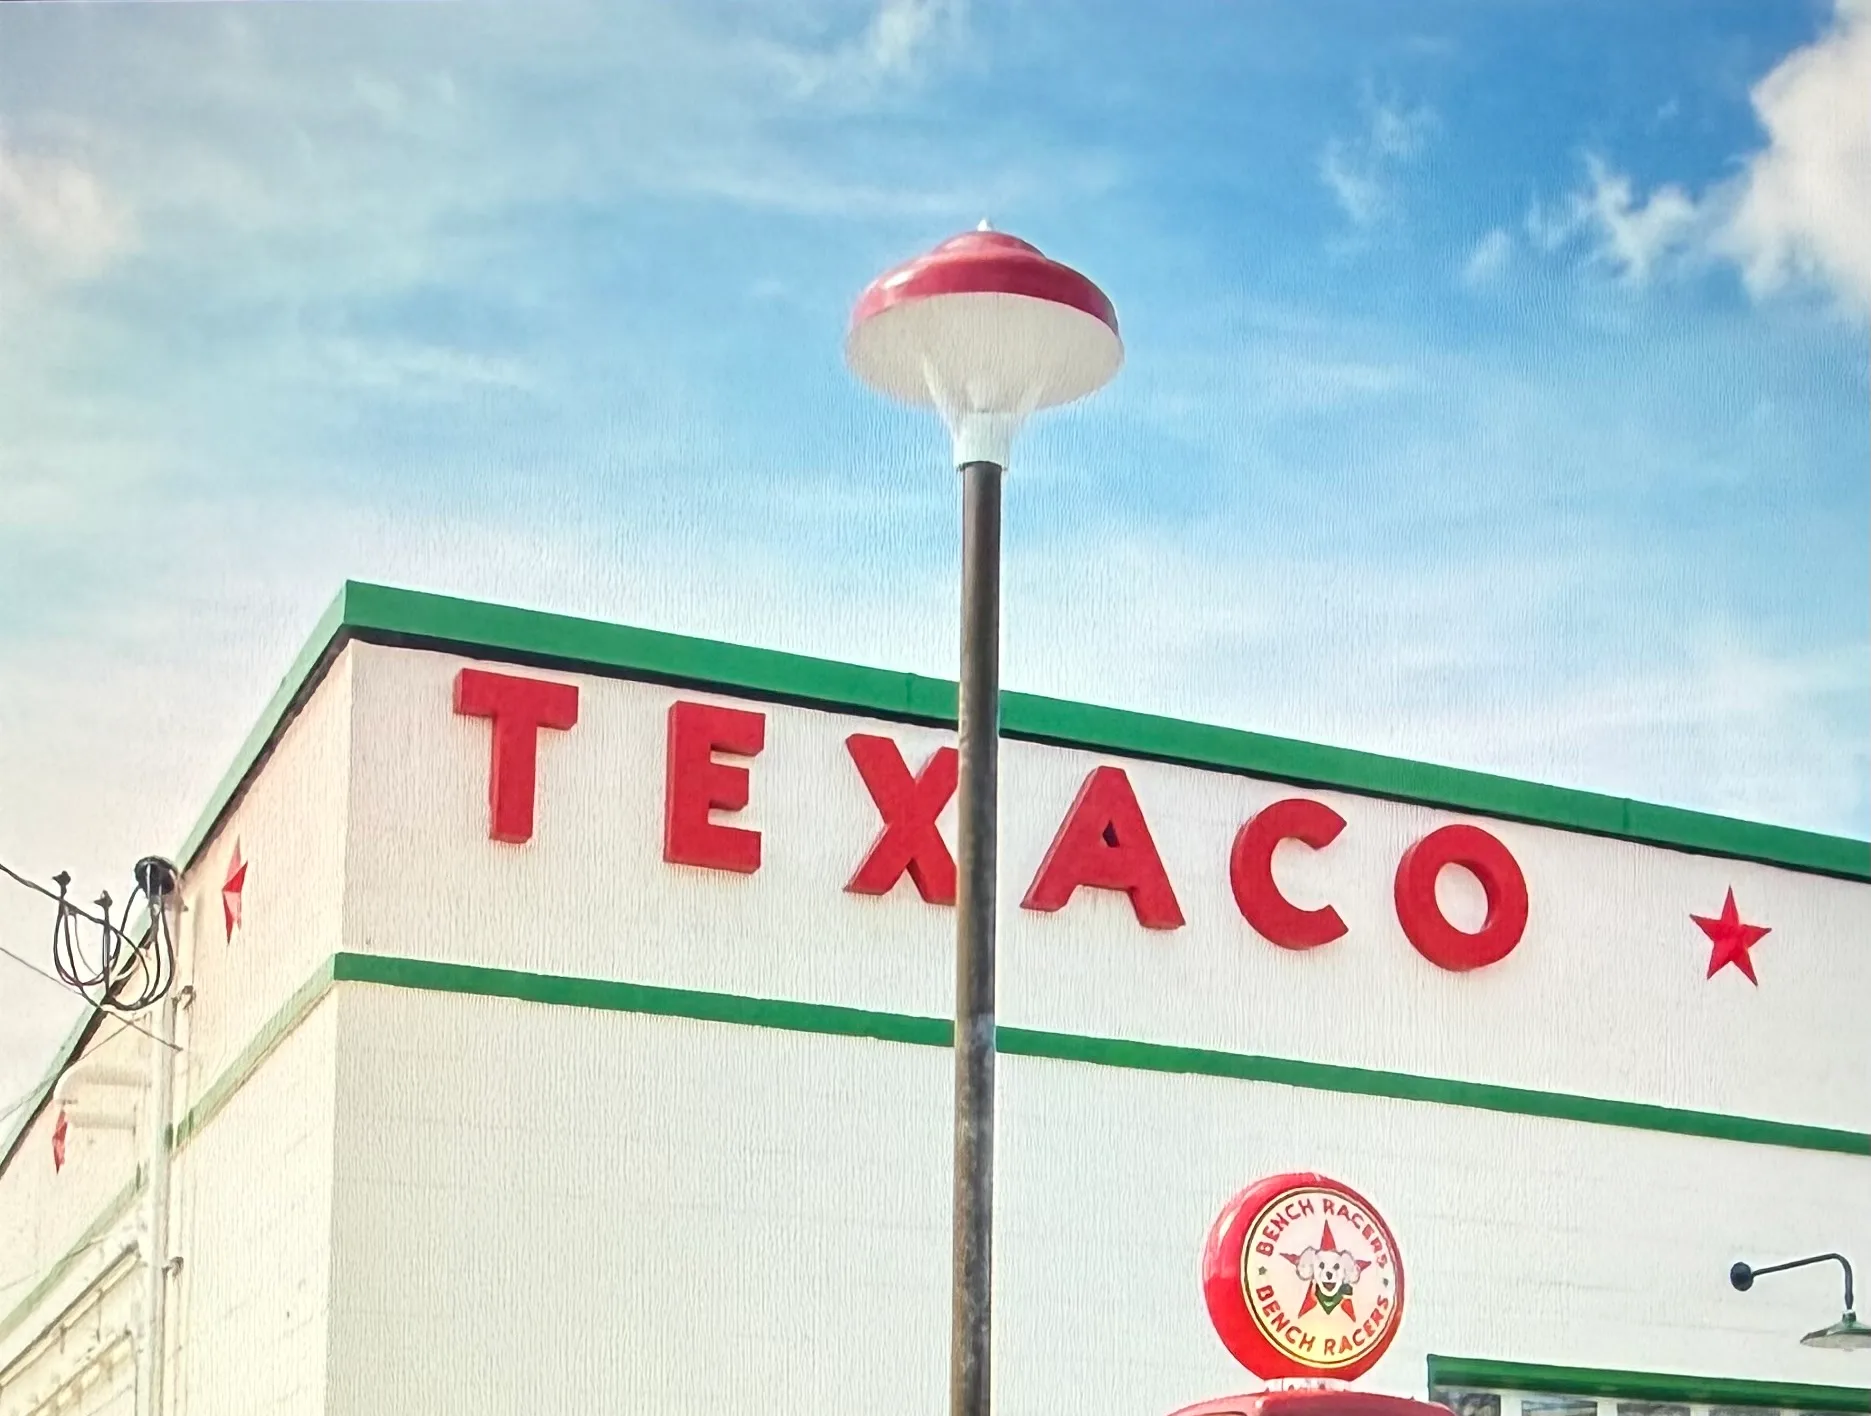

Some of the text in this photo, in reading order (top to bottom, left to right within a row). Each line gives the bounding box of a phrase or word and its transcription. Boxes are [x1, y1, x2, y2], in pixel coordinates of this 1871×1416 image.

[453, 667, 1531, 973] TEXACO
[1255, 1197, 1389, 1269] BENCH RACERS
[1255, 1284, 1390, 1356] BENCH RACERS
